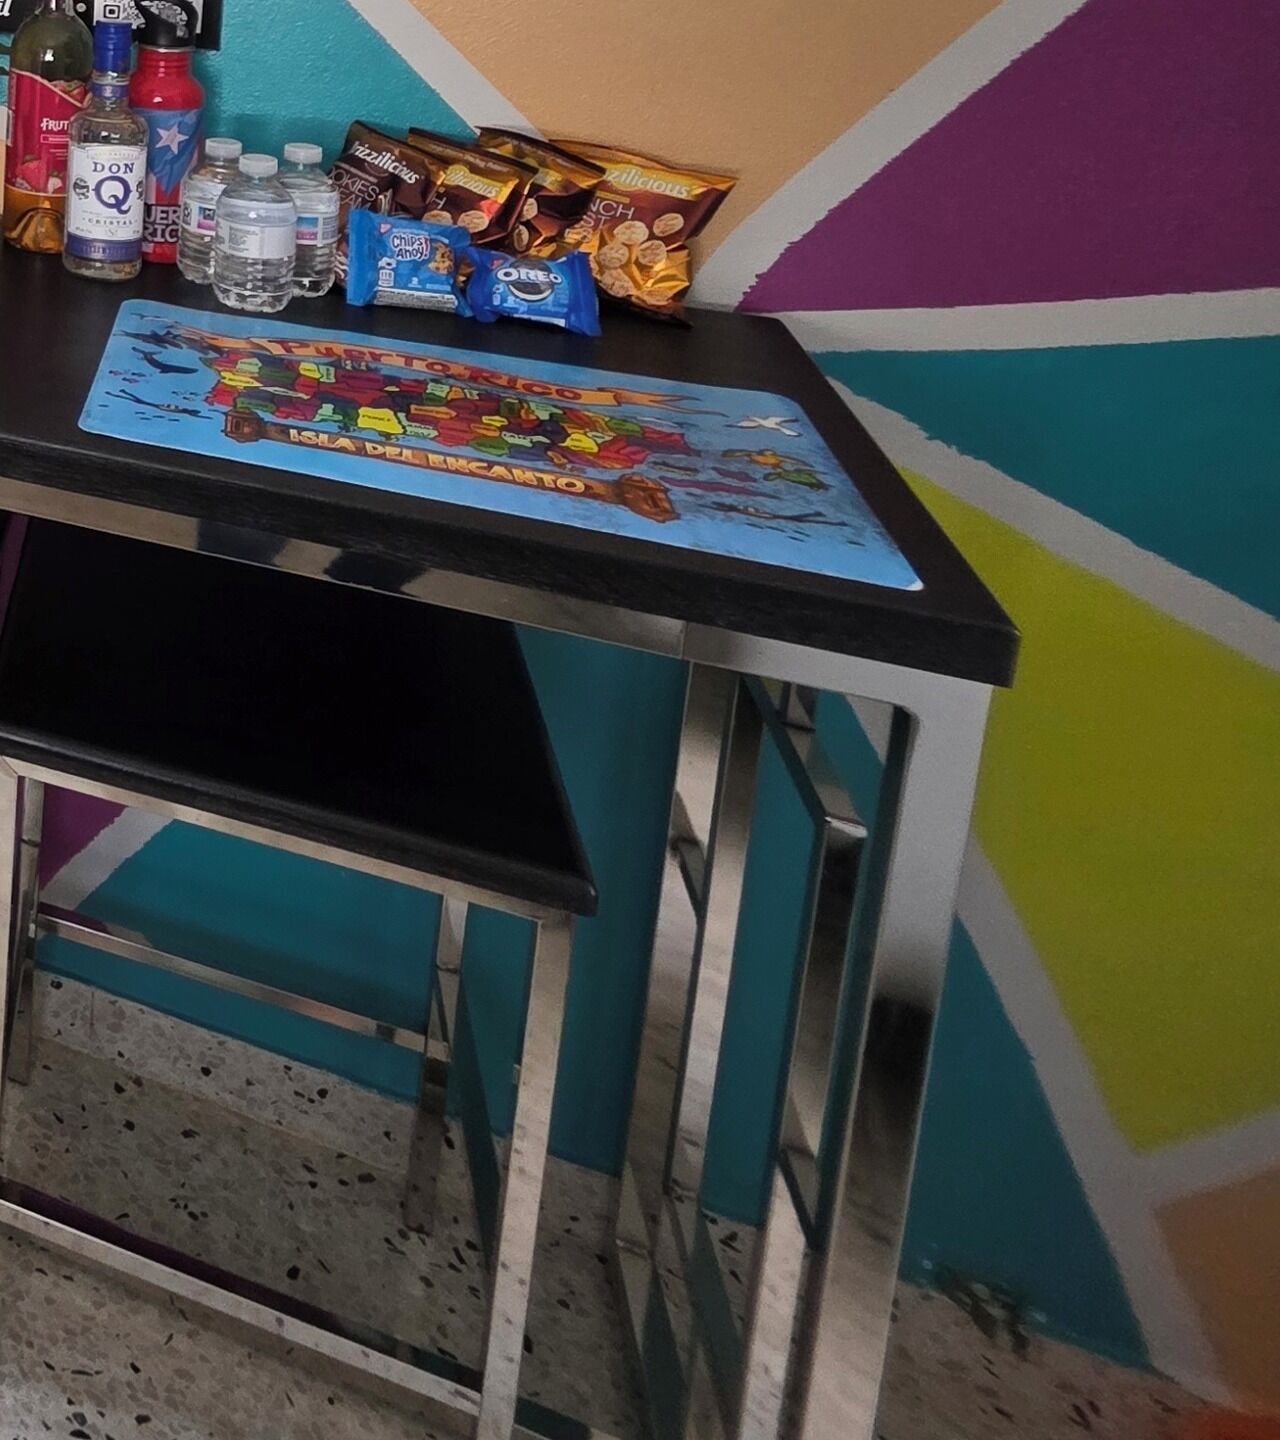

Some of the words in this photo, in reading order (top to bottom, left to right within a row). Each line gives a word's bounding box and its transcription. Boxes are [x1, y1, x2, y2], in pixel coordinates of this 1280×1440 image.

[41, 118, 69, 131] FRUT
[92, 161, 135, 174] DON
[92, 175, 133, 215] Q
[144, 205, 181, 224] UER
[143, 223, 178, 243] RIC
[391, 233, 424, 250] Chips
[396, 239, 430, 260] Ahoy!
[497, 267, 563, 284] OREO
[289, 428, 356, 451] ISLA
[365, 440, 416, 462] DEL
[427, 453, 586, 494] ENCANTO
